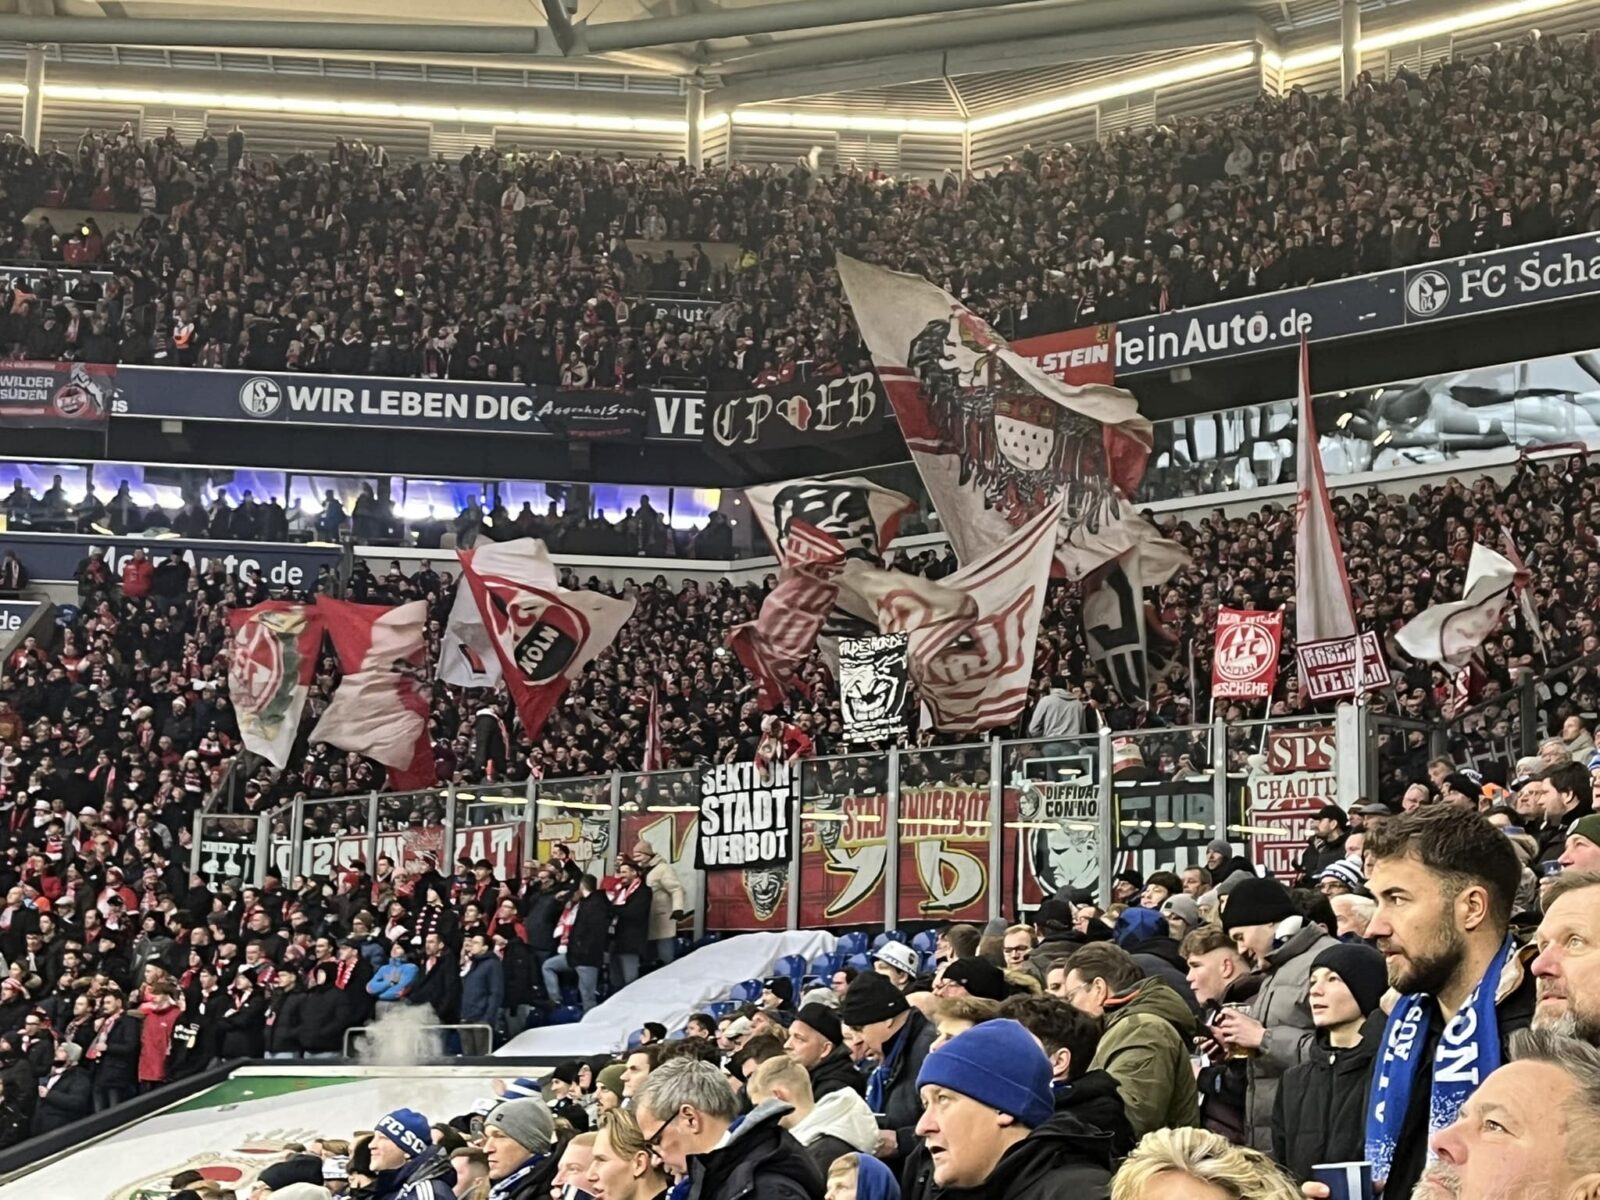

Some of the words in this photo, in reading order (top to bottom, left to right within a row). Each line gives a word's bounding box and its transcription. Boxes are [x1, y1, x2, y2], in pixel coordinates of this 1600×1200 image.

[1459, 265, 1506, 303] FC
[0, 375, 54, 388] WILDER
[287, 386, 354, 412] WIR
[361, 390, 468, 418] LEBEN
[475, 394, 541, 421] DIC
[89, 545, 304, 585] MAto.de
[518, 625, 560, 675] KÖLN
[1341, 663, 1384, 688] KLN
[702, 761, 790, 795] SEKTION
[1046, 785, 1100, 800] DIFFIDAT
[701, 788, 790, 835] STADT
[842, 788, 989, 842] STADNVERBOT
[702, 828, 789, 865] VERBOT
[1394, 1006, 1422, 1061] AUS
[379, 1115, 405, 1136] FC
[400, 1130, 427, 1154] SC
